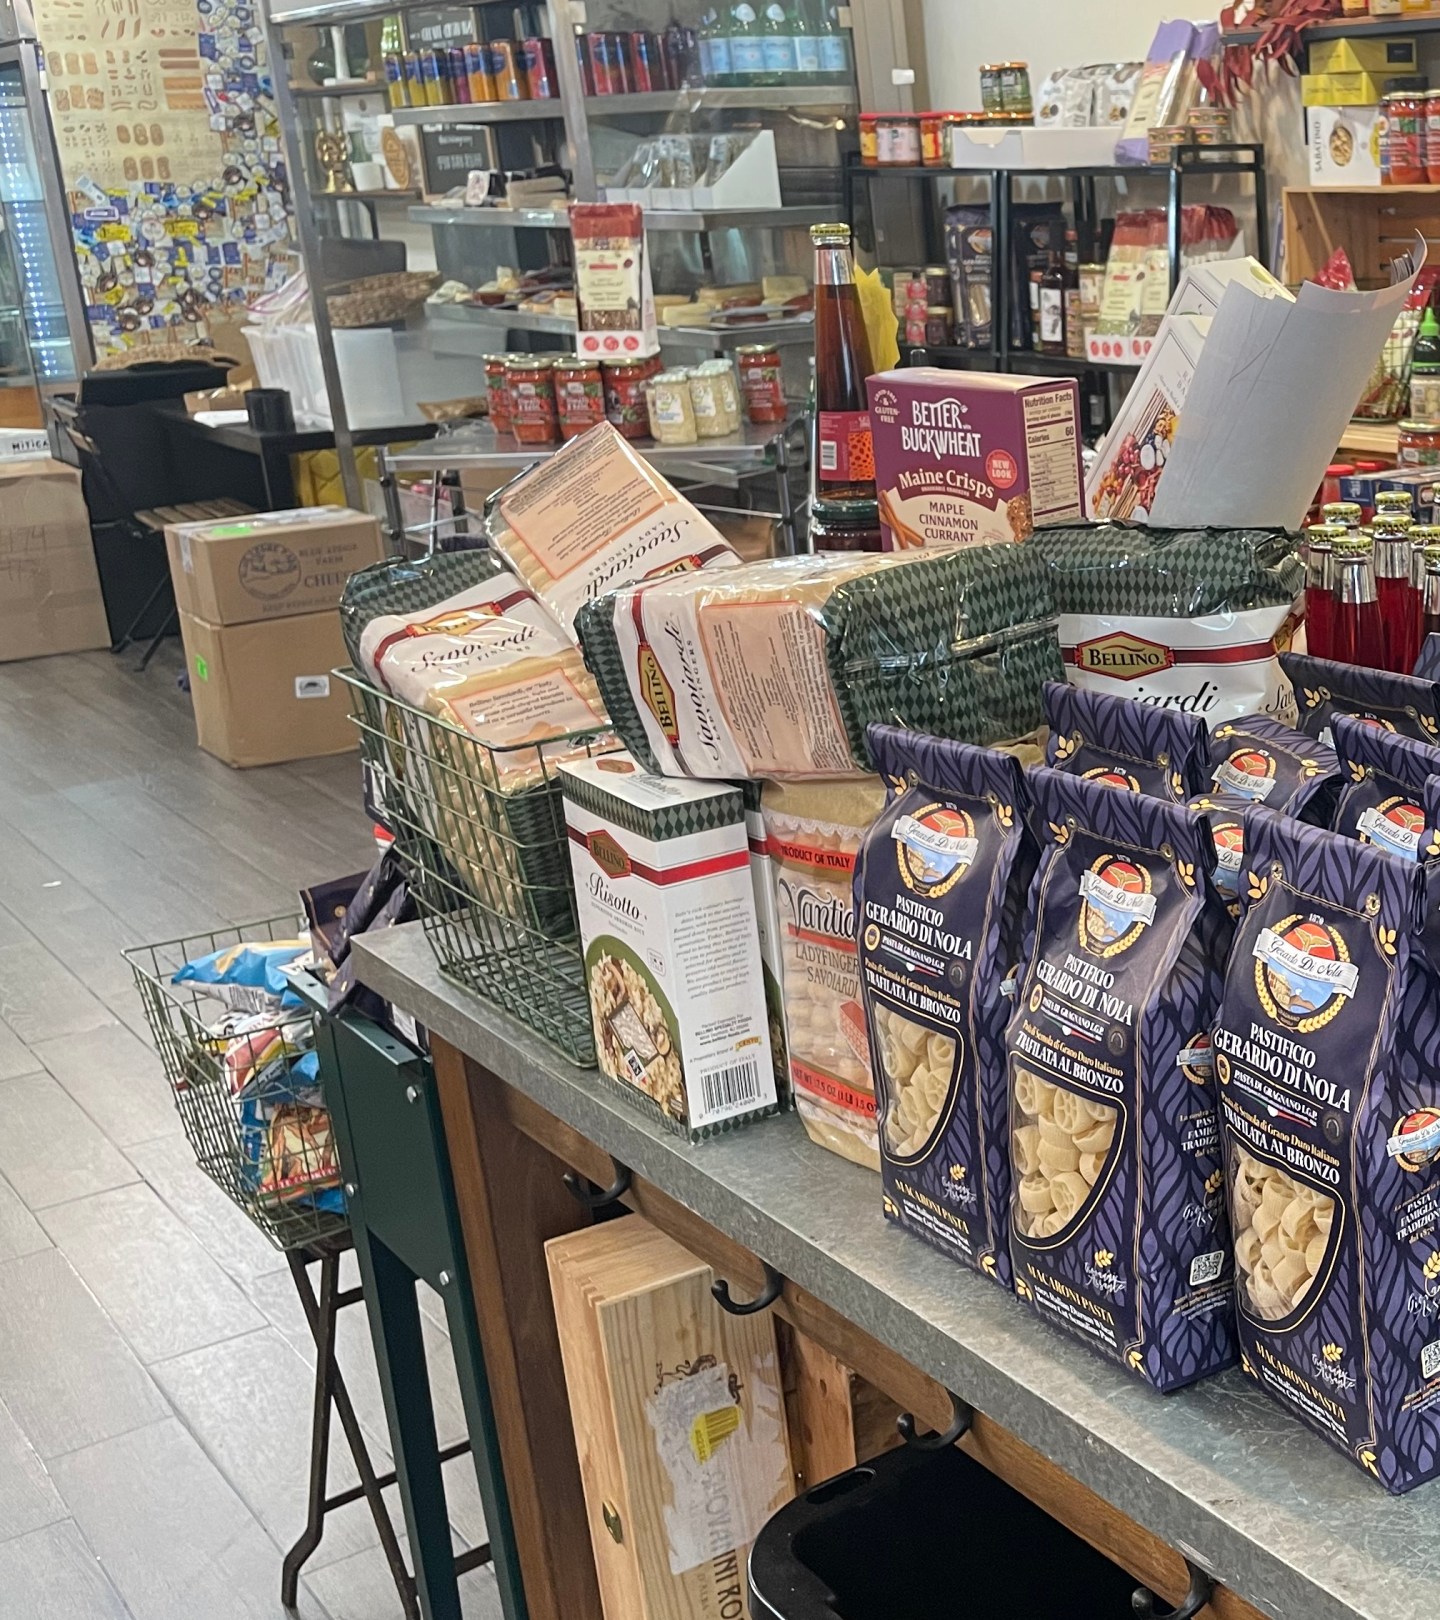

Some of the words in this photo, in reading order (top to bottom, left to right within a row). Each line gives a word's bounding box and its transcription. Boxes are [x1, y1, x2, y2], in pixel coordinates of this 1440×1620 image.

[875, 407, 900, 415] GLUTEN-
[912, 400, 962, 429] BETTER
[1024, 396, 1053, 408] Nutrition
[1055, 393, 1072, 403] Facts
[880, 415, 895, 424] FREE
[1065, 426, 1074, 436] 60
[901, 426, 981, 460] BUCKWHEAT
[1028, 434, 1050, 443] Calories
[992, 459, 1009, 469] NEW
[992, 469, 1012, 479] LOOK
[899, 468, 944, 490] Maine
[946, 469, 994, 498] Crisps
[919, 514, 979, 530] CINNAMON
[930, 501, 964, 516] MAPLE
[639, 521, 665, 542] LADY
[925, 528, 975, 541] CURRANT
[315, 556, 343, 565] FARM
[583, 518, 689, 601] Savoiardi
[588, 543, 634, 576] FINGERS
[686, 640, 708, 701] FINGERS
[647, 656, 673, 728] BELLINO
[665, 620, 720, 761] Savoiardi
[593, 839, 624, 868] BELLINO
[781, 845, 813, 863] PRODUCT
[815, 854, 825, 864] OF
[827, 854, 850, 868] ITALY
[589, 872, 640, 920] Risotto
[896, 894, 944, 927] PASTIFICIO
[865, 900, 918, 939] GERARDO
[919, 924, 934, 946] DI
[934, 928, 973, 961] NOLA
[1309, 913, 1325, 925] 1870
[795, 941, 861, 977] LADYFINGER
[1063, 953, 1115, 990] PASTIFICIO
[807, 966, 858, 999] SAVOIARDI
[865, 968, 907, 1003] TRAFILATA
[907, 991, 920, 1007] AL
[920, 994, 961, 1024] BRONZO
[1036, 959, 1081, 1000] GERARDO
[1080, 983, 1100, 1009] DI
[1100, 990, 1133, 1026] NOLA
[1250, 1022, 1316, 1069] PASTIFICIO
[700, 1063, 728, 1074] PRODUCT
[739, 1053, 755, 1063] ITALY
[1015, 1030, 1058, 1068] TRAFILATA
[1058, 1058, 1073, 1077] AL
[1072, 1061, 1124, 1094] BRONZO
[1214, 1027, 1283, 1078] GERARDO
[1285, 1065, 1305, 1088] DI
[1303, 1071, 1350, 1113] NOLA
[1223, 1102, 1268, 1151] TRAFILATA
[1270, 1137, 1287, 1158] AL
[1287, 1145, 1340, 1185] BRONZO
[1400, 1199, 1439, 1228] FAMIGLIA
[1406, 1193, 1432, 1212] PASTA
[1256, 1340, 1311, 1394] MACARONI
[1311, 1386, 1346, 1422] PASTA
